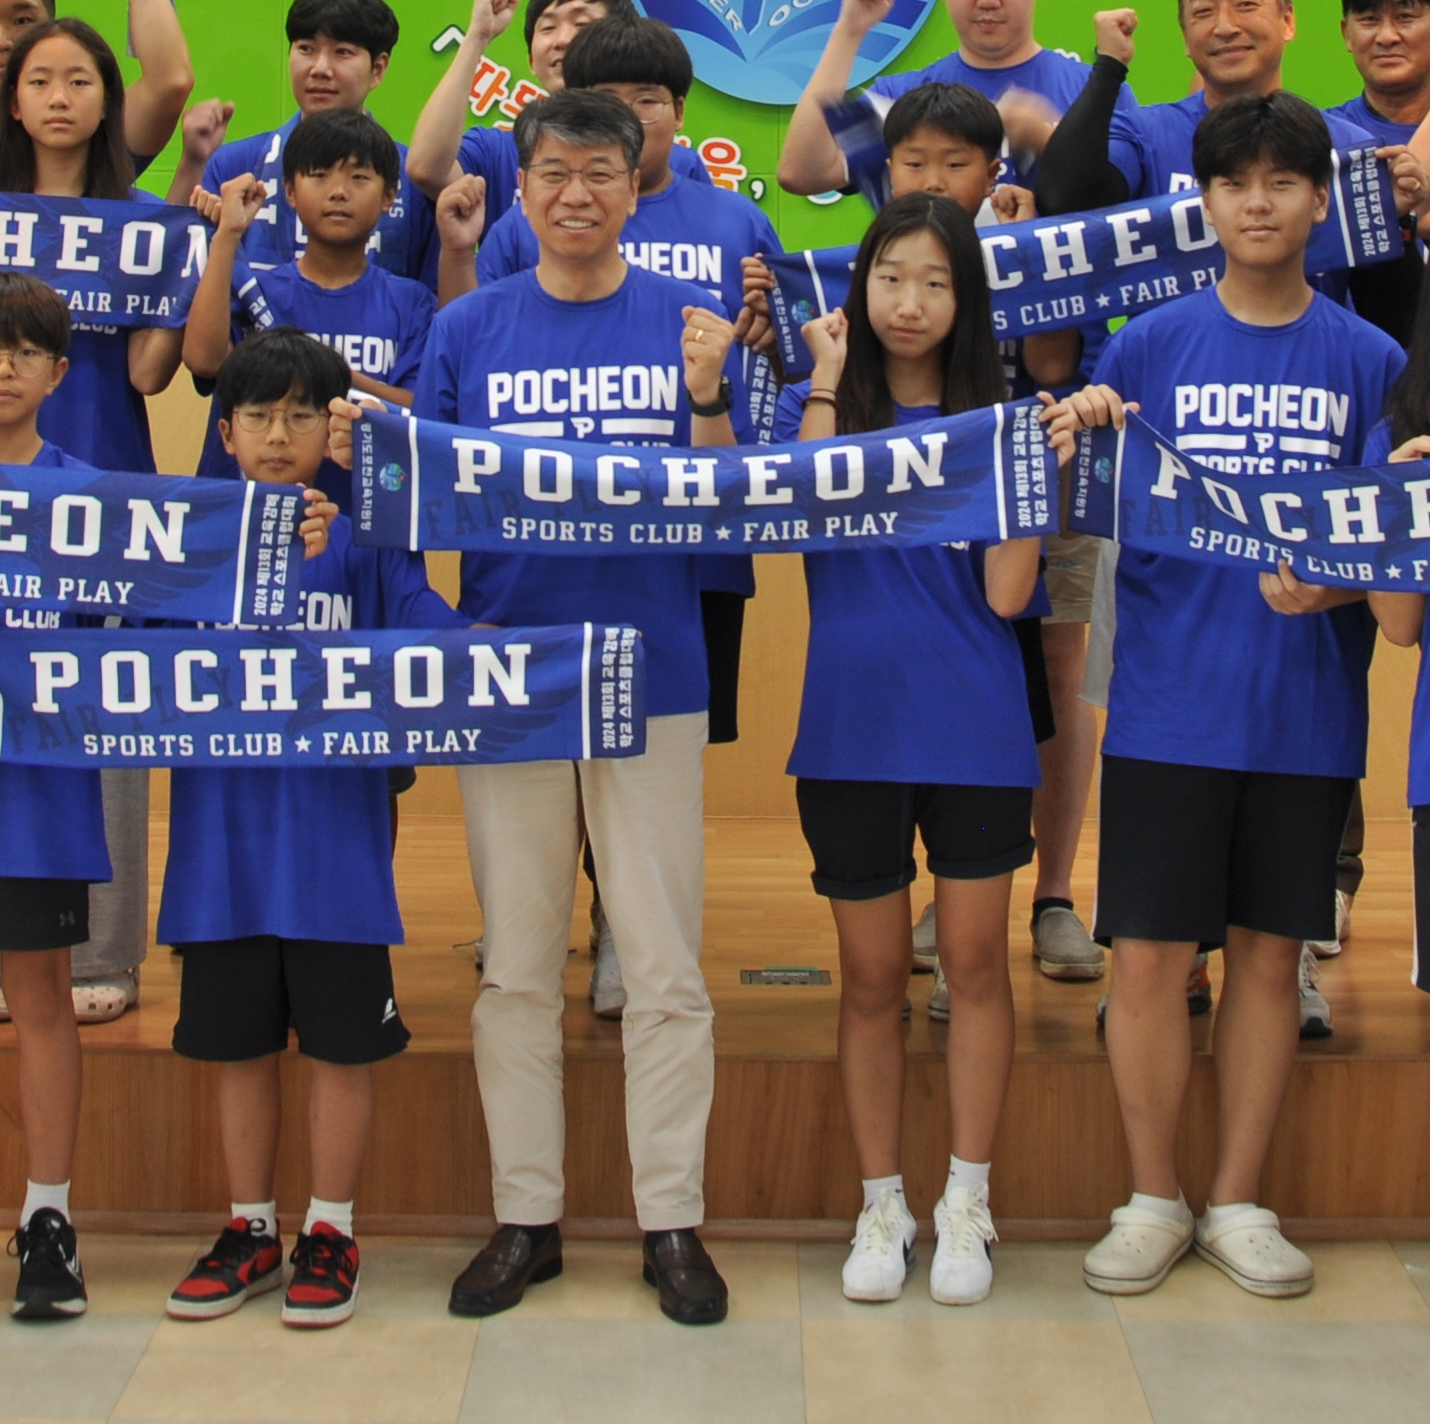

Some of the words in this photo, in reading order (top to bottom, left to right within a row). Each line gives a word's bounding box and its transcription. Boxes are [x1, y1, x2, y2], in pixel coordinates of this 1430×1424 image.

[1353, 196, 1371, 231] 제13회
[1360, 232, 1377, 257] 2024
[1375, 228, 1390, 254] 학교
[125, 294, 177, 317] PLA
[1020, 297, 1086, 329] CLUB
[1121, 276, 1180, 308] FAIR
[488, 364, 678, 418] POCHEON
[1175, 382, 1348, 437] POCHEON
[1012, 405, 1029, 456] 교육감배
[360, 422, 374, 532] 경기도포천교육지원청
[452, 431, 950, 507] POCHEON
[1014, 459, 1030, 498] 제13회
[260, 493, 281, 545] 교육감배
[501, 516, 618, 545] SPORTS
[629, 517, 704, 545] CLUB
[742, 517, 811, 543] FAIR
[824, 510, 899, 538] PLAY
[1017, 499, 1032, 528] 2024
[1034, 498, 1049, 526] 학교
[274, 495, 298, 586] 스포츠클럽대회
[1189, 526, 1294, 565] SPORTS
[1307, 555, 1374, 582] CLUB
[257, 548, 273, 586] 제13회
[57, 578, 135, 606] PLAY
[254, 587, 268, 616] 2024
[270, 588, 285, 616] 학교
[601, 627, 620, 678] 교육감배
[29, 642, 533, 714] POCHEON
[618, 627, 637, 718] 스포츠클럽대회
[601, 681, 616, 719] 제13회
[82, 732, 194, 757] SPORTS
[207, 732, 284, 756] CLUB
[322, 731, 391, 756] FAIR
[405, 728, 482, 754] PLAY
[602, 721, 616, 749] 2024
[619, 721, 634, 748] 학교
